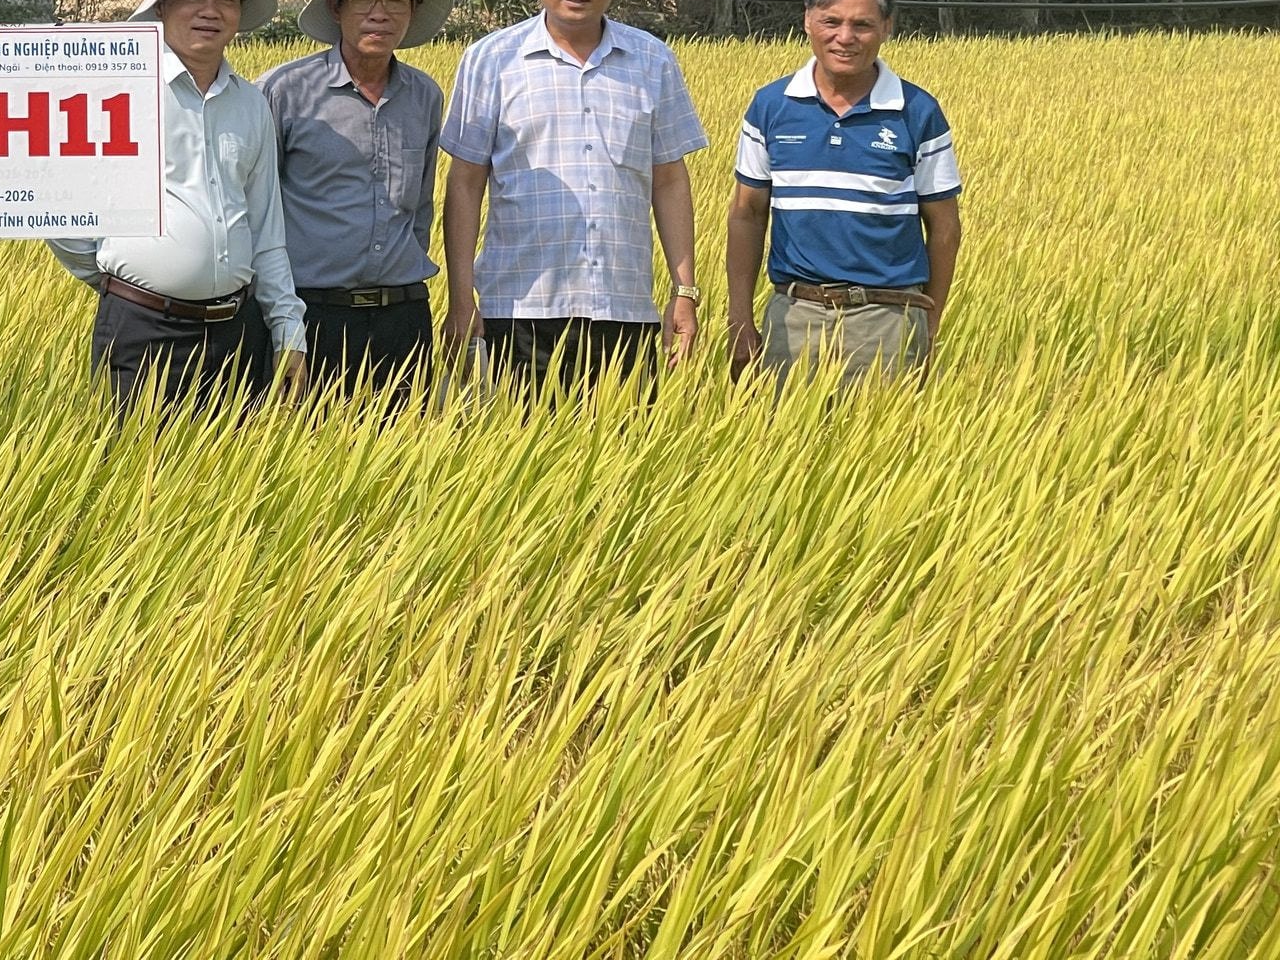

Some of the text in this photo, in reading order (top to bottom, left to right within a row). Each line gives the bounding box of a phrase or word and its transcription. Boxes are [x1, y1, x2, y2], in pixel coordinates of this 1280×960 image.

[14, 39, 59, 59] NGHIỆP
[63, 37, 106, 57] QUẢNG
[110, 38, 140, 56] NGÃI
[0, 62, 21, 73] Ngãi
[34, 62, 56, 72] Điện
[57, 62, 84, 73] thoại:
[85, 62, 108, 71] 0919
[110, 62, 127, 71] 357
[130, 62, 148, 71] 801
[27, 211, 67, 229] QUẢNG
[71, 211, 100, 227] NGÃI
